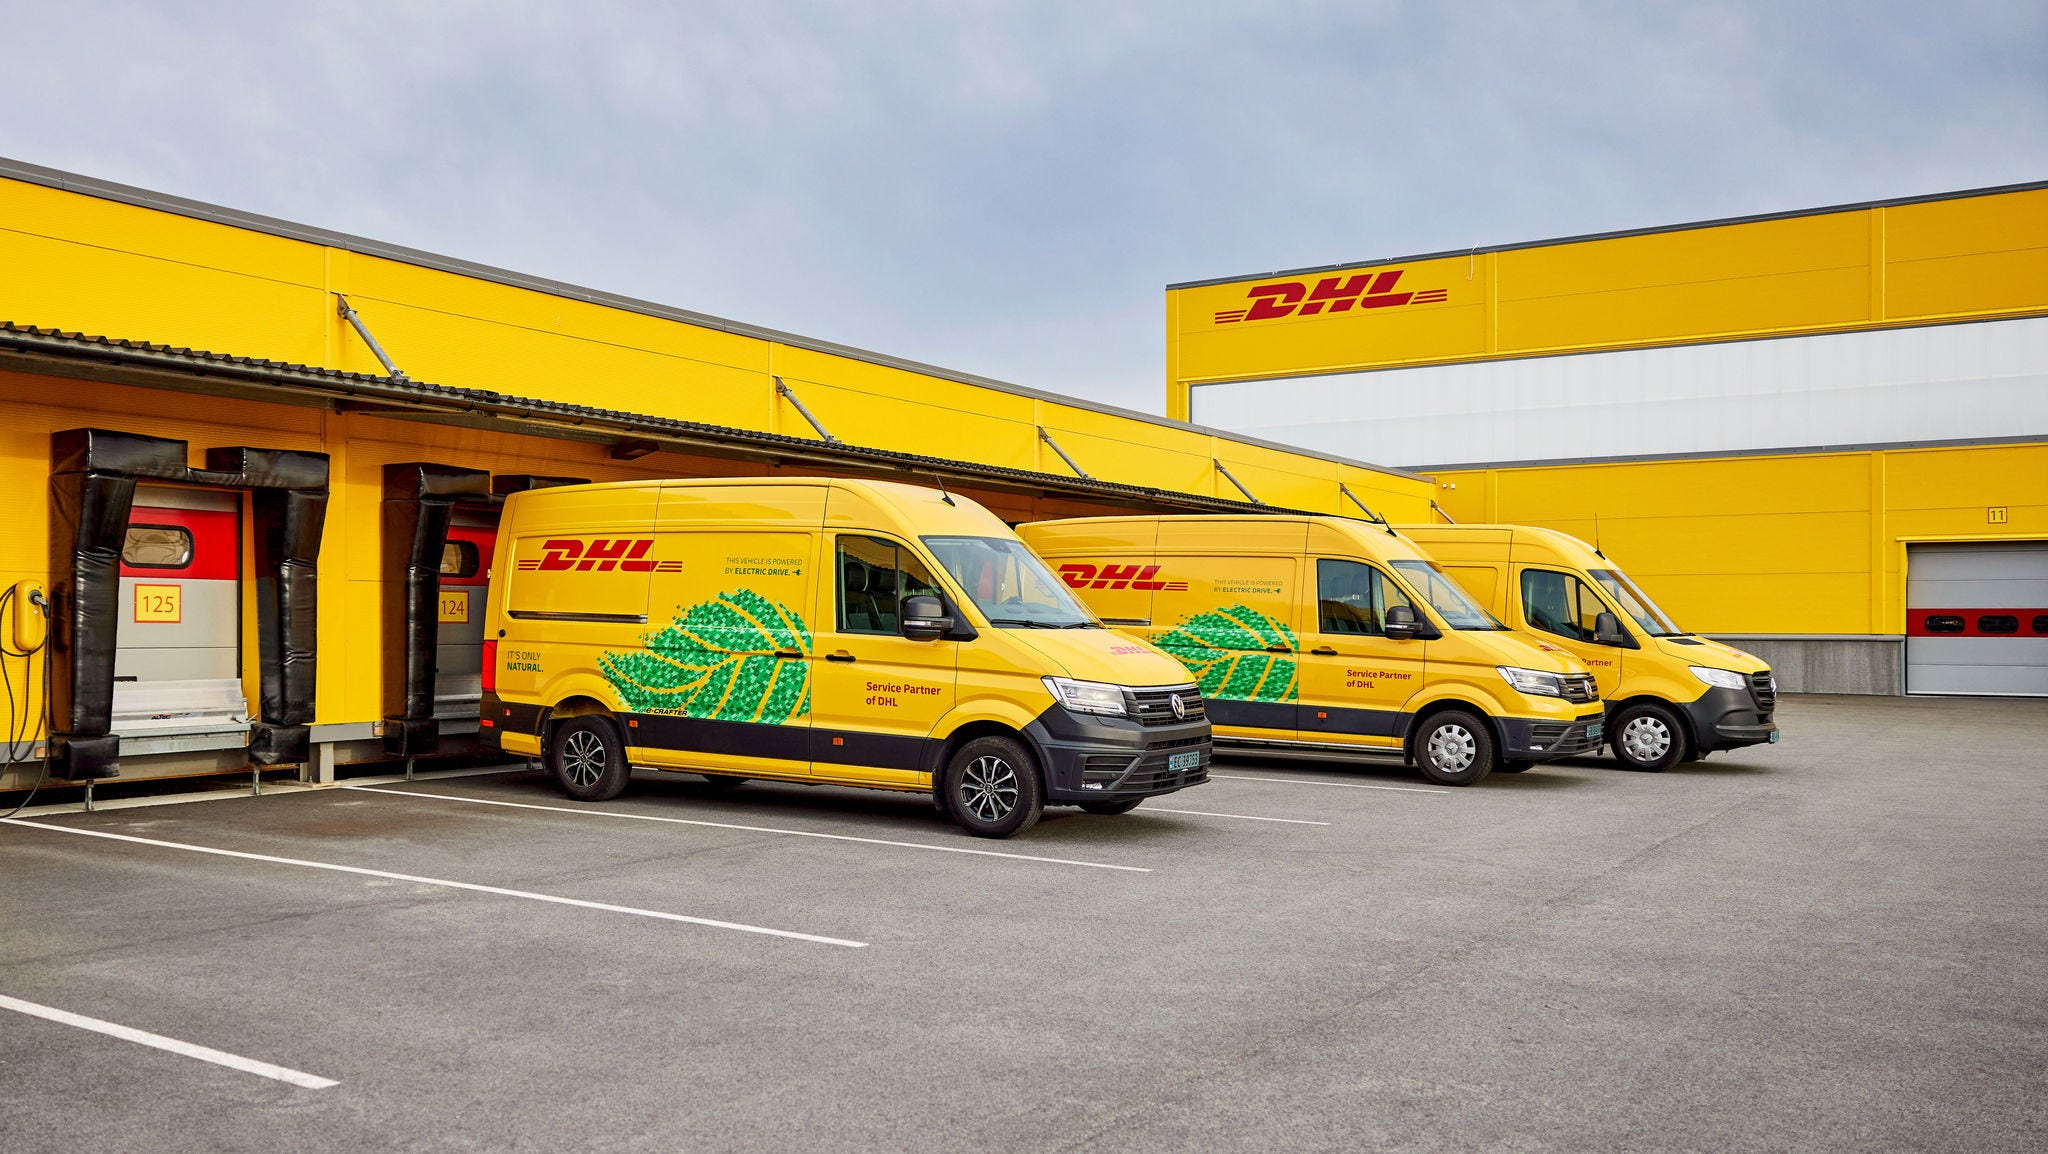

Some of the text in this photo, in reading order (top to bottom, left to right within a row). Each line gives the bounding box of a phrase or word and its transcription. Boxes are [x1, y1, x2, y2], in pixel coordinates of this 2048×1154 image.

[1243, 270, 1415, 321] DHL
[1990, 510, 2003, 521] 11
[538, 539, 659, 572] DHL
[740, 557, 764, 565] VEHICLE
[773, 558, 803, 566] POWERED
[735, 567, 767, 575] ELECTRIC
[768, 568, 791, 576] DRIVE.
[1058, 564, 1167, 590] DHL
[143, 595, 174, 613] 125
[441, 600, 464, 615] 124
[522, 651, 541, 661] ONLY
[1109, 646, 1151, 655] DHL
[506, 662, 544, 672] NATURAL.
[1347, 669, 1412, 680] Service Partner
[866, 681, 942, 695] Service Partner
[1357, 680, 1374, 688] DHL
[866, 696, 898, 707] of DHL
